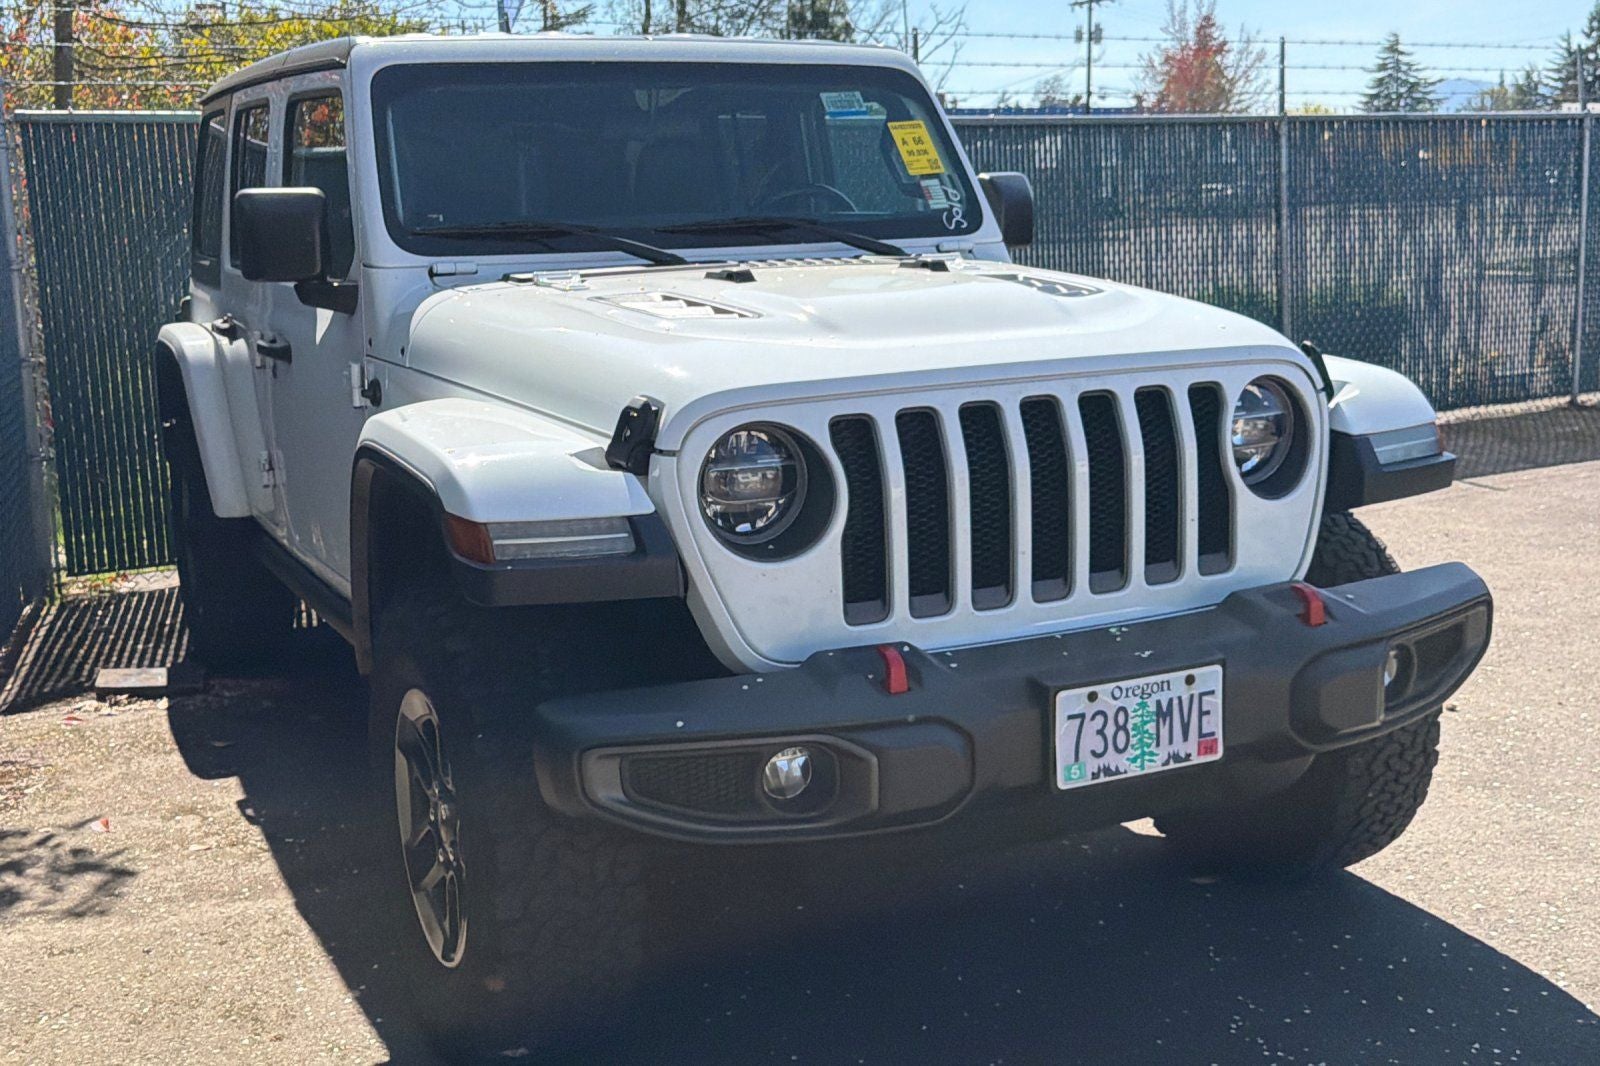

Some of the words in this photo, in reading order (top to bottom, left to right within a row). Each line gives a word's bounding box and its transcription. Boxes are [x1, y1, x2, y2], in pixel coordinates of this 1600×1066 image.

[942, 186, 967, 229] Sold
[1111, 680, 1171, 701] Oregon
[1067, 706, 1130, 762] 738
[1156, 691, 1215, 747] MVE
